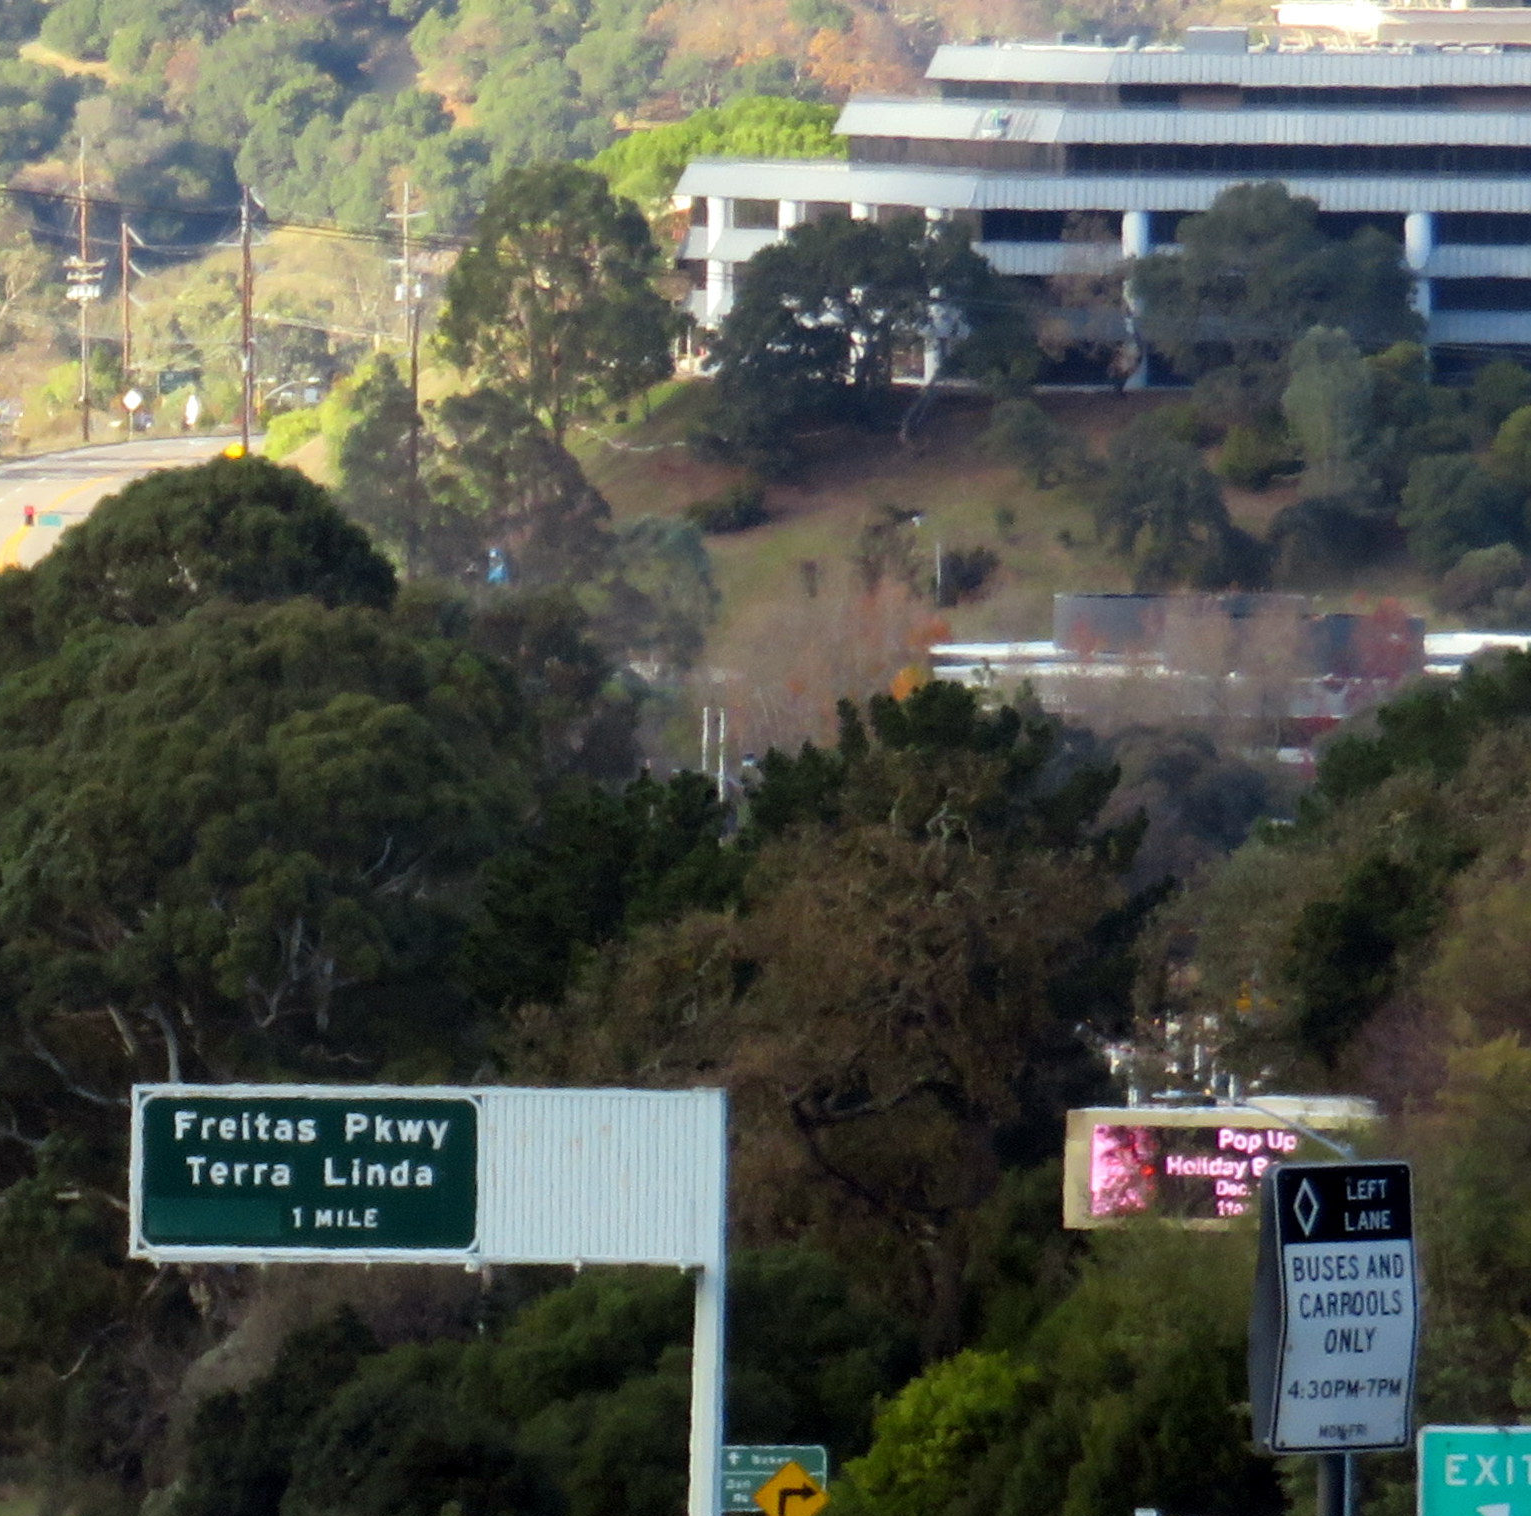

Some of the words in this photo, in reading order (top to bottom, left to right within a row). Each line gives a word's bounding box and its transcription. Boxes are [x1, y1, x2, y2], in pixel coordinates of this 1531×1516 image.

[173, 1111, 317, 1142] Freitas
[345, 1112, 449, 1150] Pkwy
[1218, 1129, 1262, 1152] Pop
[1266, 1130, 1297, 1152] Up
[186, 1156, 291, 1187] Terra
[323, 1157, 434, 1187] Linda
[1166, 1156, 1247, 1179] Holiday
[1346, 1179, 1387, 1200] LEFT
[292, 1207, 301, 1228] 1
[315, 1208, 379, 1228] MILE
[1344, 1210, 1391, 1231] LANE
[1293, 1255, 1359, 1282] BUSES
[1366, 1254, 1404, 1279] AND
[1299, 1290, 1402, 1319] CARPOOLS
[1324, 1327, 1377, 1354] ONLY
[1288, 1378, 1402, 1399] 4:30PM-7PM
